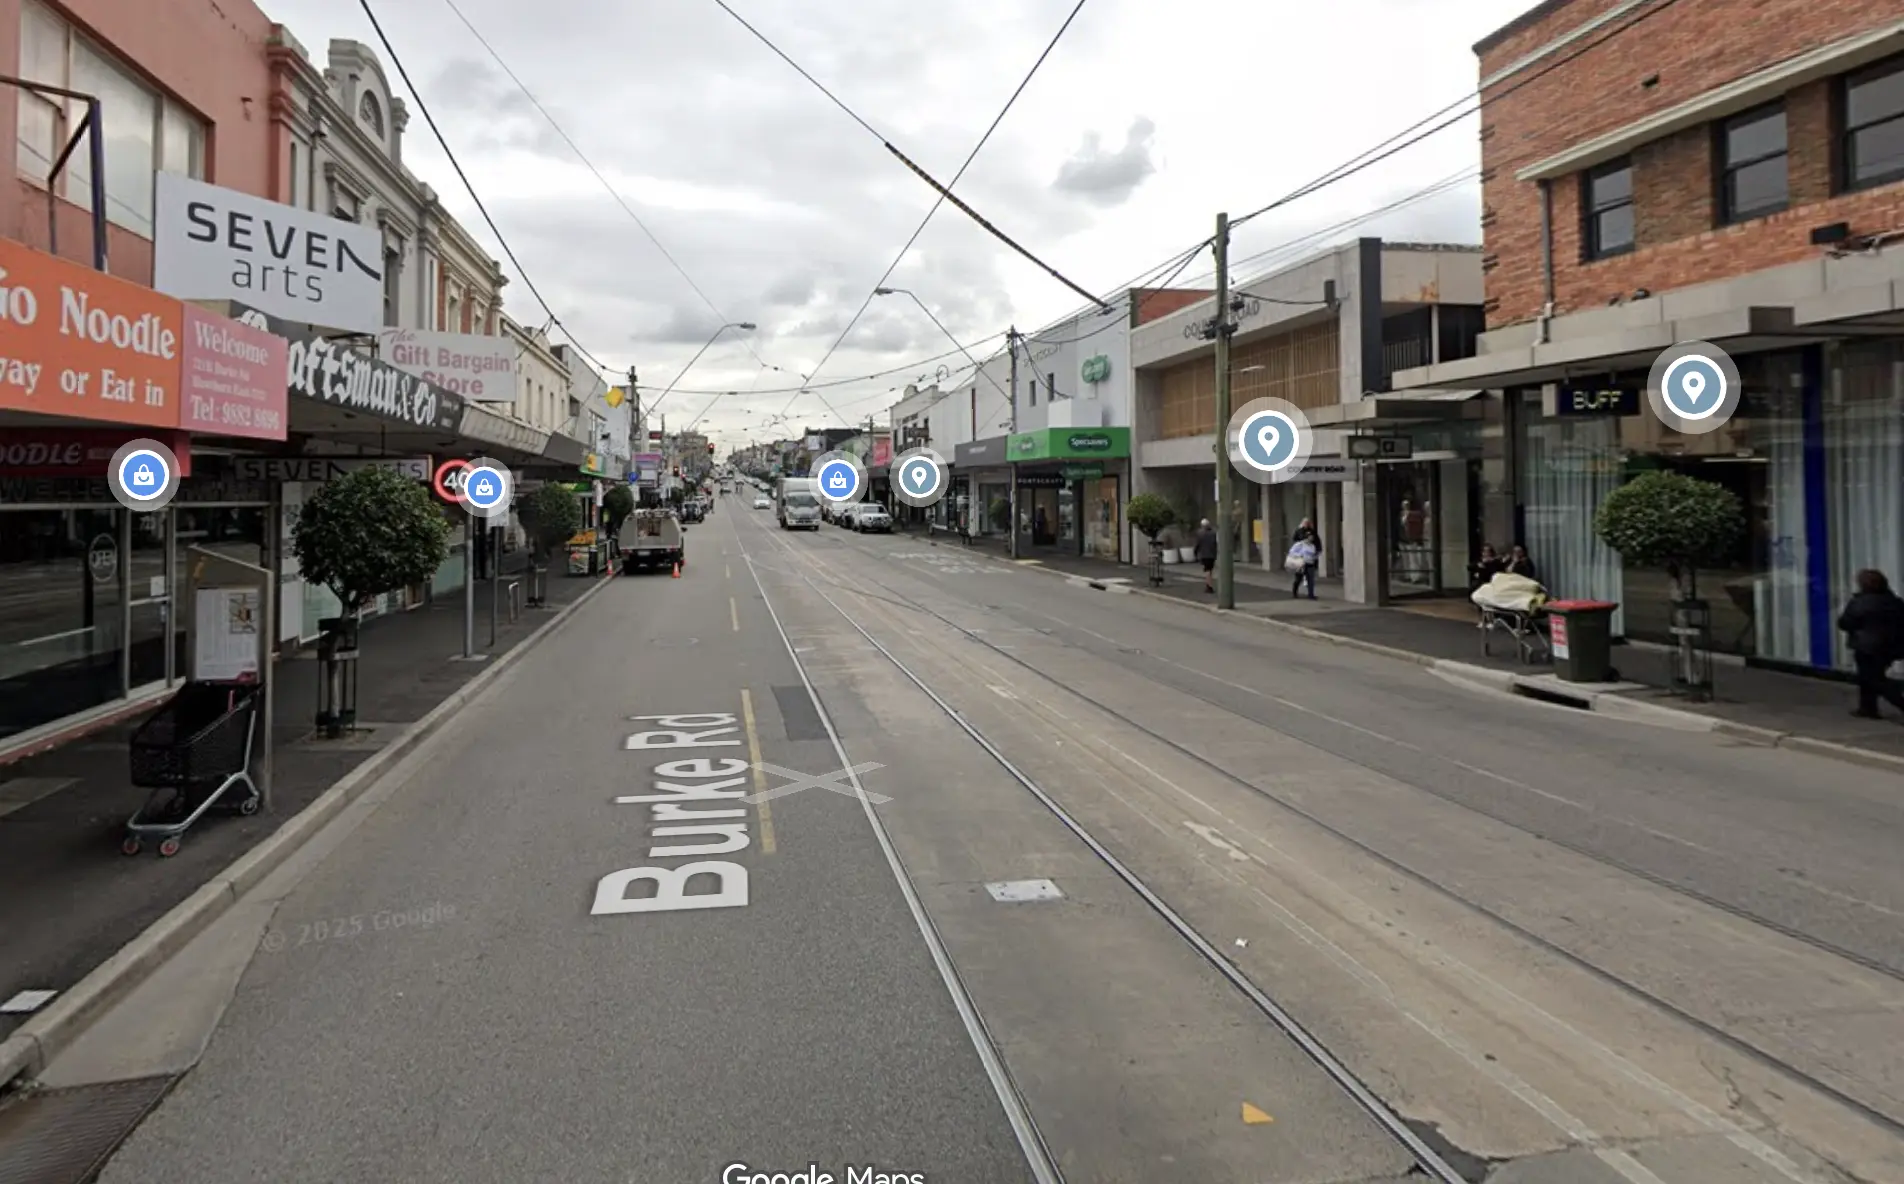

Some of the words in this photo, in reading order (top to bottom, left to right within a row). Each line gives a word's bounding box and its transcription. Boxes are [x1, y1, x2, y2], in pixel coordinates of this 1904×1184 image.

[187, 201, 382, 282] SEVEN
[231, 259, 323, 302] arts
[60, 285, 175, 360] Noodle
[193, 320, 269, 367] Welcome
[392, 344, 431, 367] Gift
[437, 347, 511, 375] Bargain
[60, 368, 90, 396] or
[101, 368, 136, 403] Eat
[144, 379, 165, 407] in
[1573, 390, 1622, 410] BUFF
[243, 460, 348, 480] SEVEN
